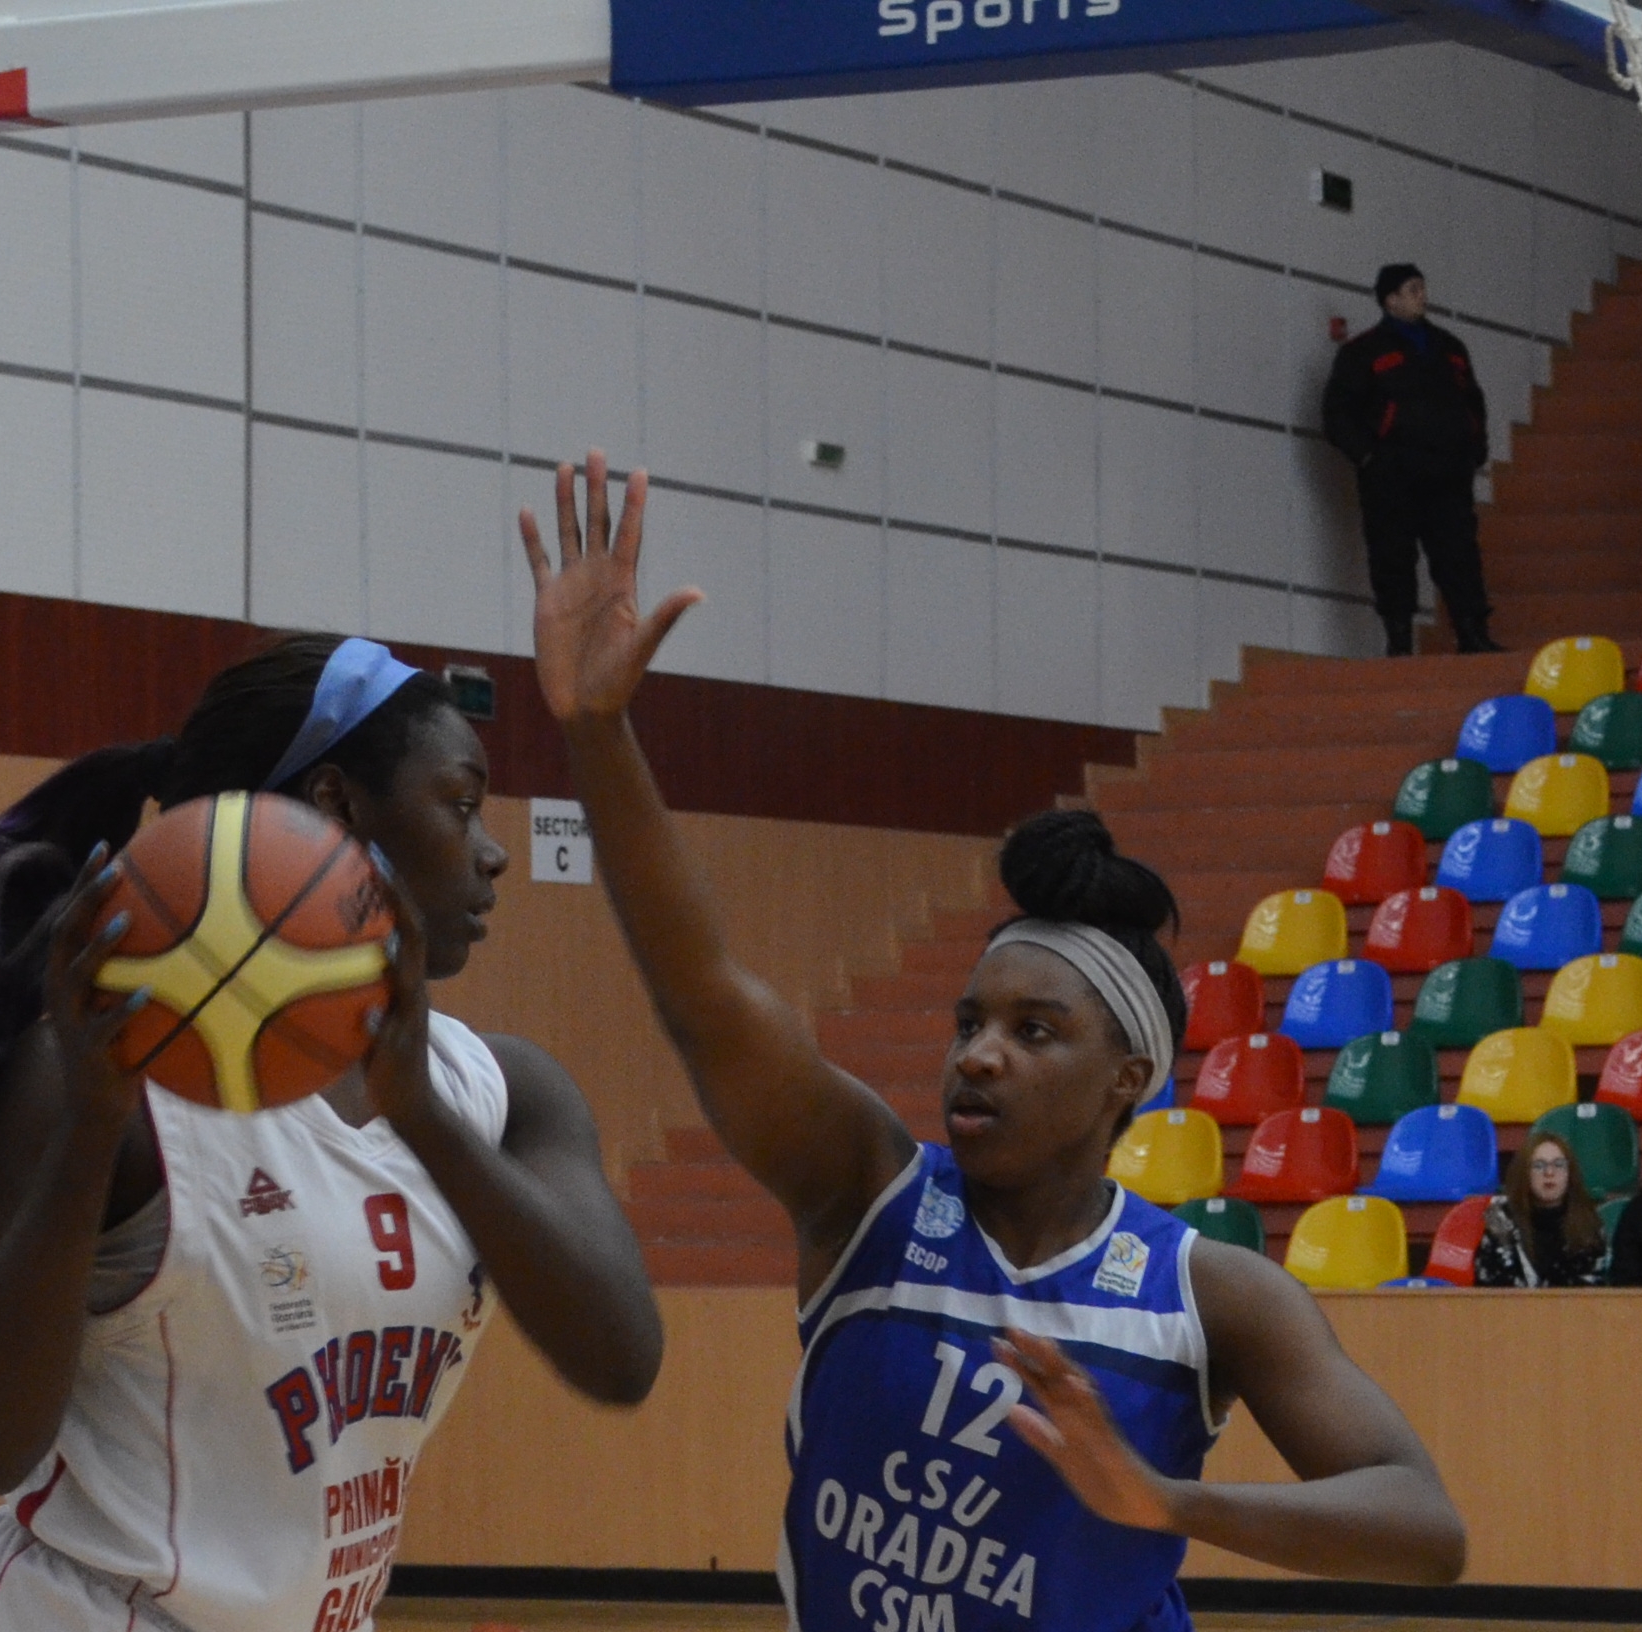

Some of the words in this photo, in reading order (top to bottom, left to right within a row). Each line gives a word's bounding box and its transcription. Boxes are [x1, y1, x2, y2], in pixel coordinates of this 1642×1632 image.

[556, 845, 570, 873] C
[364, 1192, 417, 1291] 9
[264, 1325, 463, 1475] PHOEN
[920, 1340, 1024, 1458] 12
[882, 1450, 1003, 1527] CSU
[814, 1477, 1037, 1620] ORADEA
